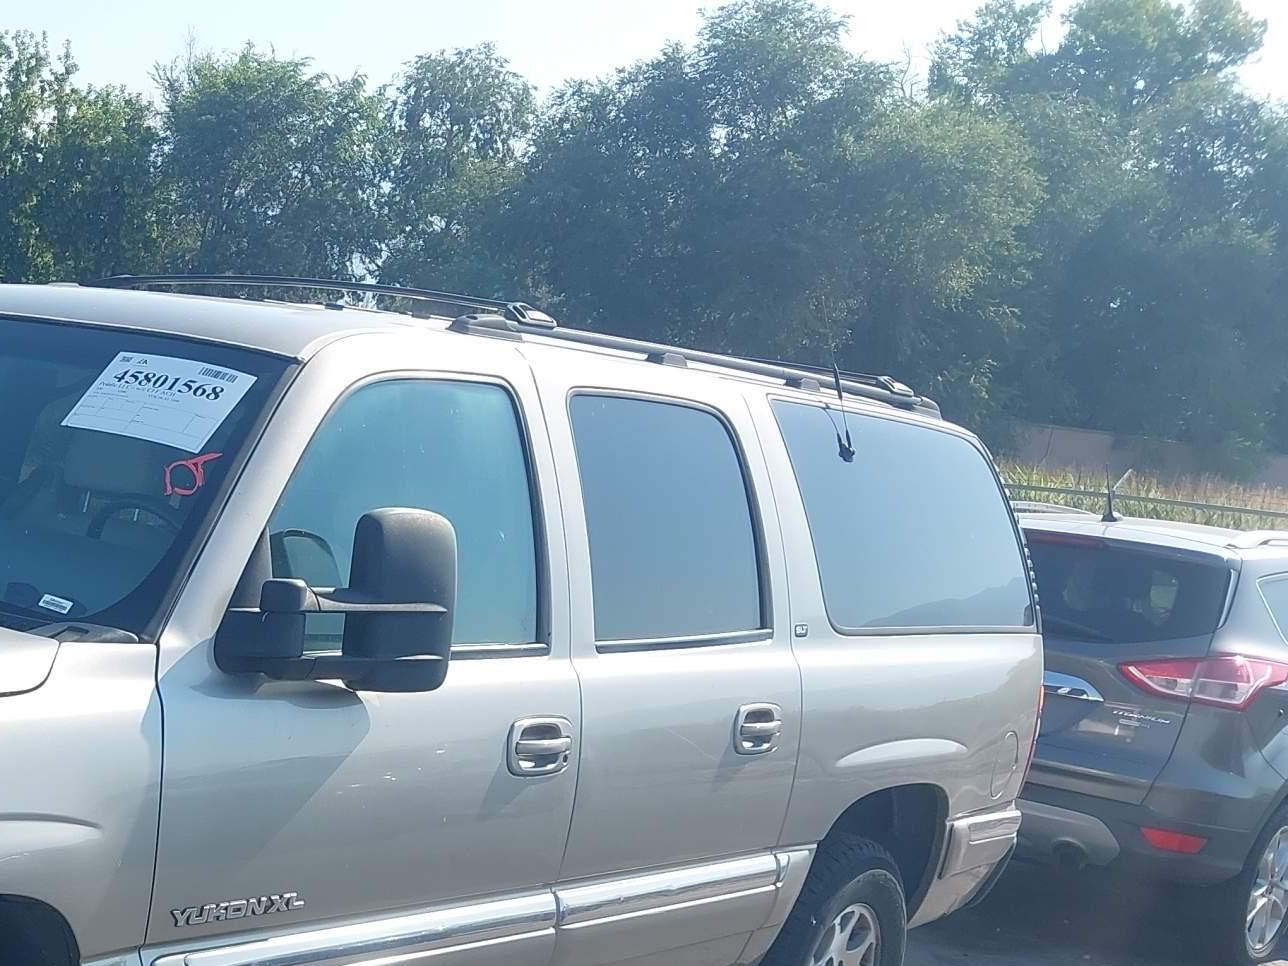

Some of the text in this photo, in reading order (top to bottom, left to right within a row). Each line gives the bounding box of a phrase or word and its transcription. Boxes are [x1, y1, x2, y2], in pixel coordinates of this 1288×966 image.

[112, 368, 226, 402] 45801568
[171, 892, 305, 927] YUKON XL
